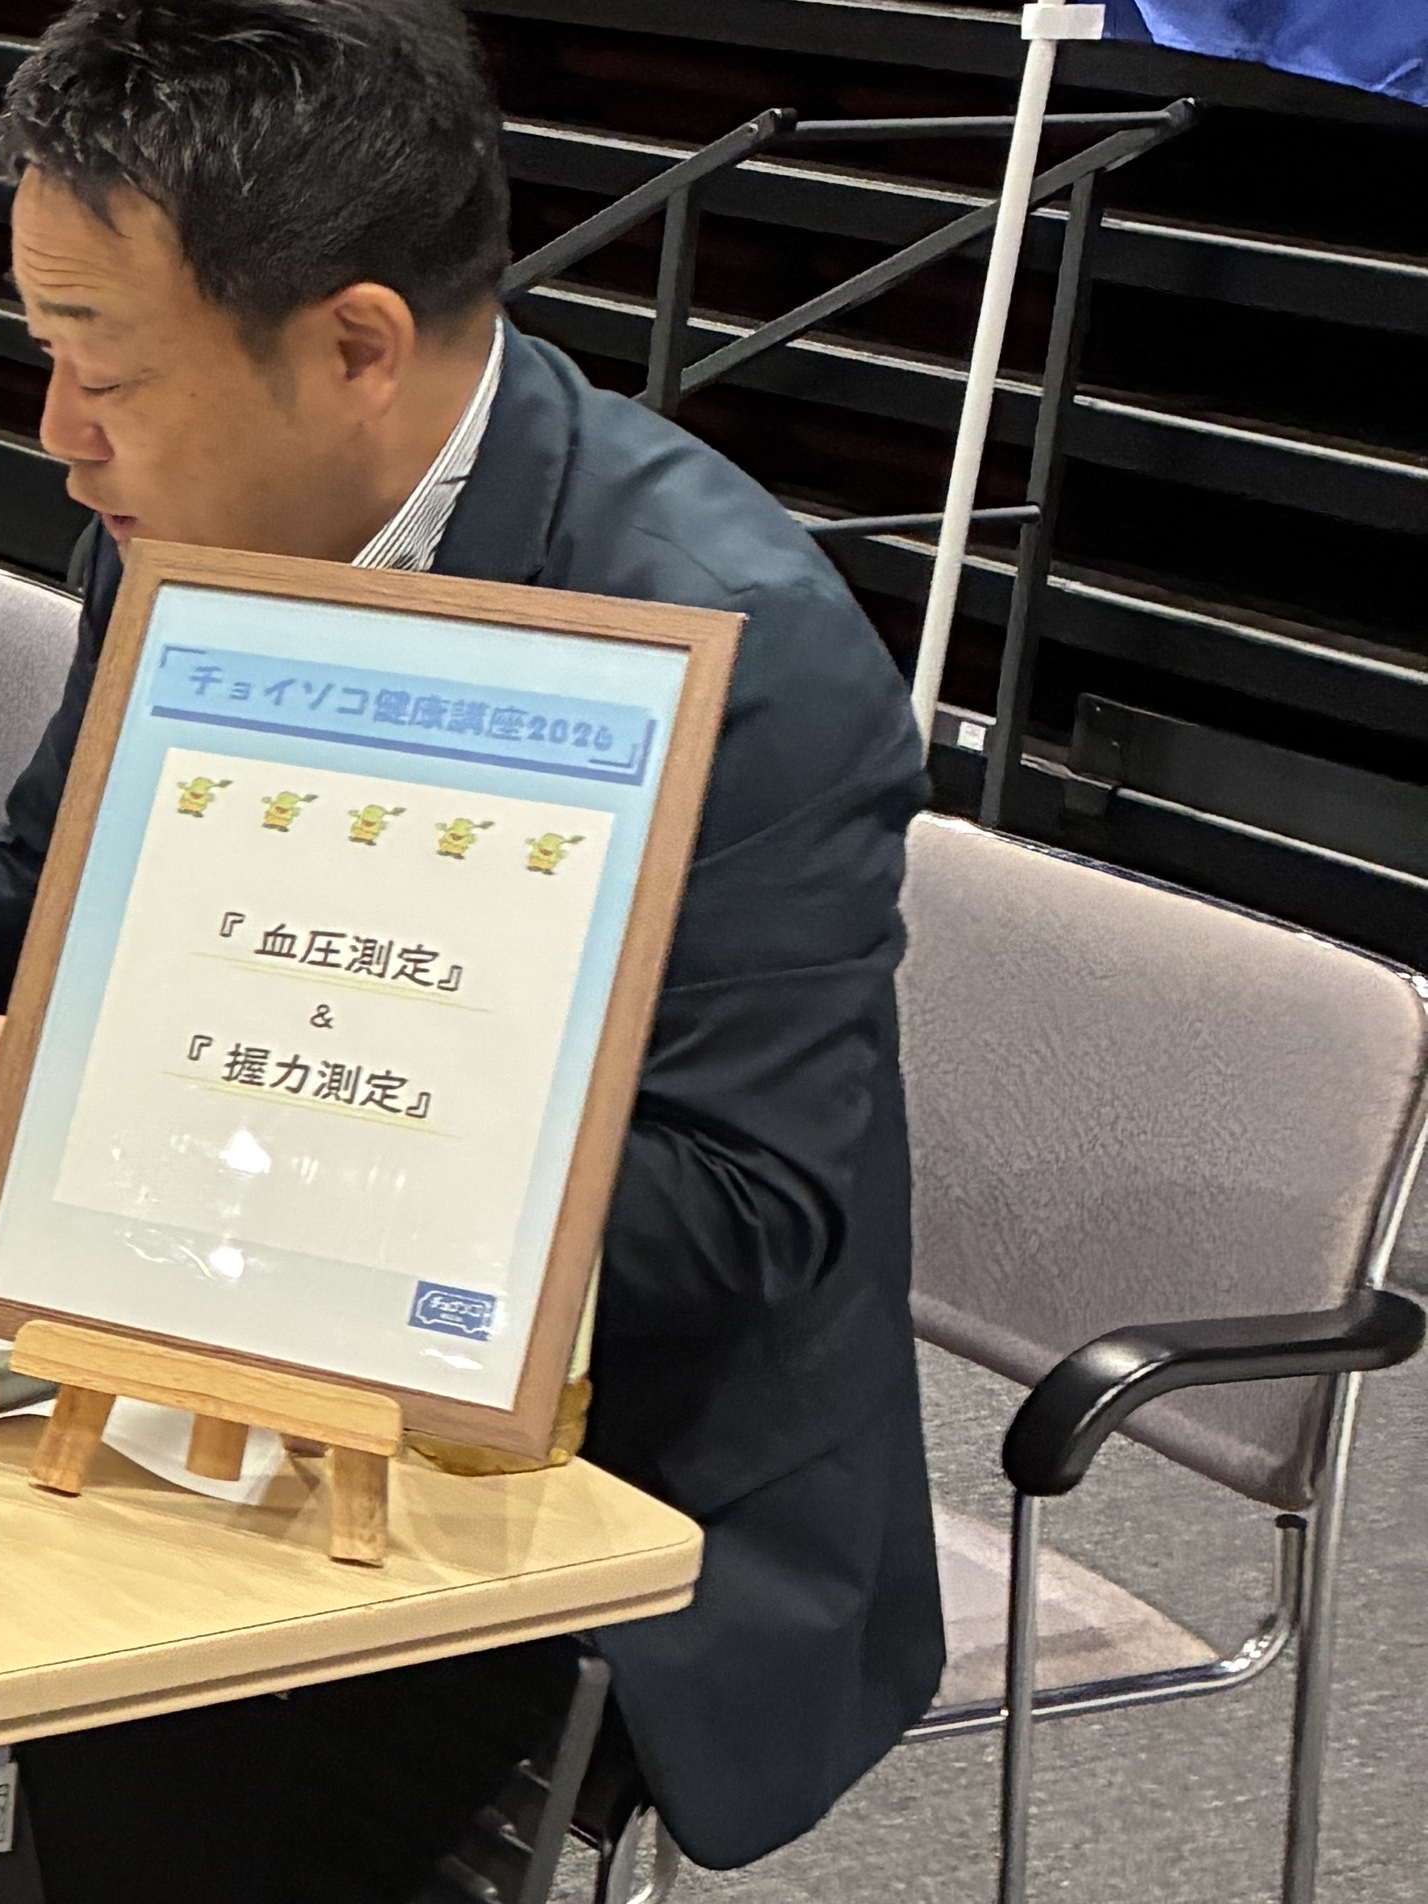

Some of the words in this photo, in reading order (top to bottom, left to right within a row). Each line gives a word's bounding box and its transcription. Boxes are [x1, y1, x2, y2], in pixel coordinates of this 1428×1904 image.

[189, 665, 613, 750] チョイソコ健康講座2026
[220, 912, 462, 993] 『血圧測定』
[309, 1002, 335, 1030] &
[189, 1035, 431, 1119] 『握力測定』
